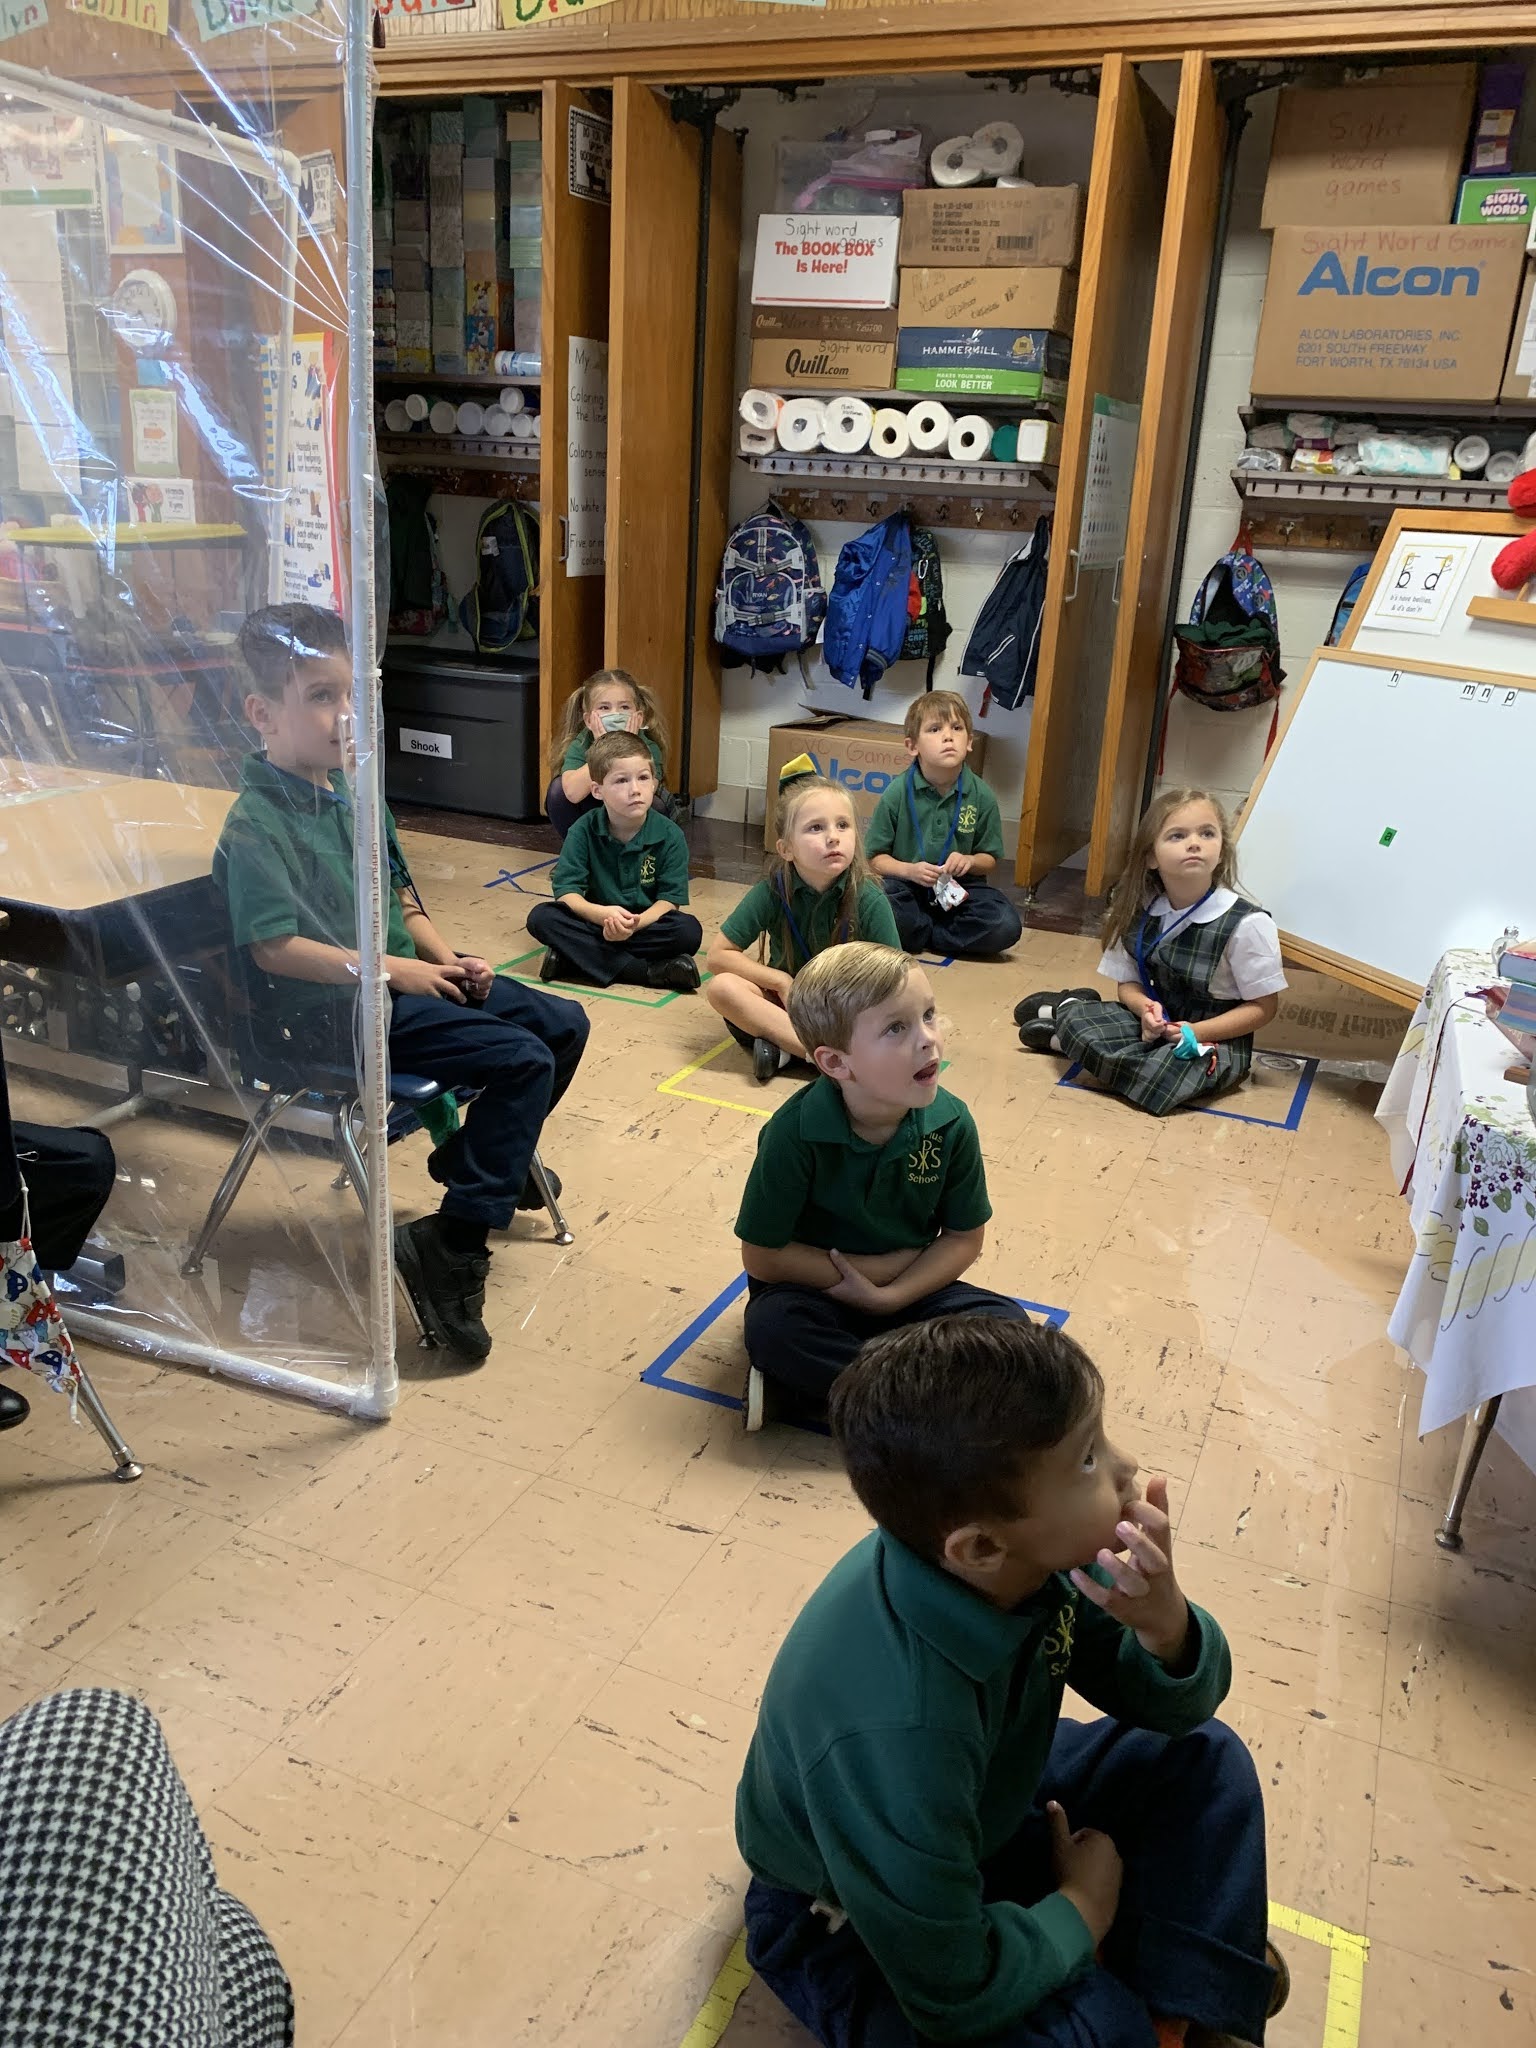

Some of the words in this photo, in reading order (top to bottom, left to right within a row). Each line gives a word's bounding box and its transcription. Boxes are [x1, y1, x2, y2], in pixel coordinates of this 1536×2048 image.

[1485, 192, 1527, 205] SIGHT
[1480, 204, 1528, 217] WORDS
[785, 217, 821, 242] Sight
[825, 221, 858, 237] word
[774, 241, 799, 256] The
[802, 241, 841, 256] BOOK
[845, 242, 875, 257] BOX
[840, 237, 884, 254] games
[1302, 232, 1369, 254] Sight
[1378, 231, 1439, 251] Word
[796, 259, 808, 273] Is
[811, 259, 848, 274] Here!
[1297, 251, 1481, 296] Alcon
[1300, 328, 1339, 340] ALCON
[818, 340, 851, 361] Sight
[856, 343, 888, 355] word
[1327, 343, 1366, 354] SOUTH
[1370, 344, 1427, 355] FREEWAY
[575, 347, 590, 374] My
[785, 348, 850, 377] Quill.com
[1296, 356, 1327, 367] FORT
[1380, 357, 1394, 368] TX
[1434, 358, 1457, 369] USA
[935, 379, 957, 389] LOOK
[961, 379, 993, 390] BETTER
[1390, 671, 1399, 683] h
[1463, 684, 1475, 696] m
[1481, 688, 1491, 699] n
[1504, 691, 1515, 704] p
[410, 739, 441, 754] Shook
[1384, 831, 1393, 841] a
[923, 1132, 943, 1143] ius
